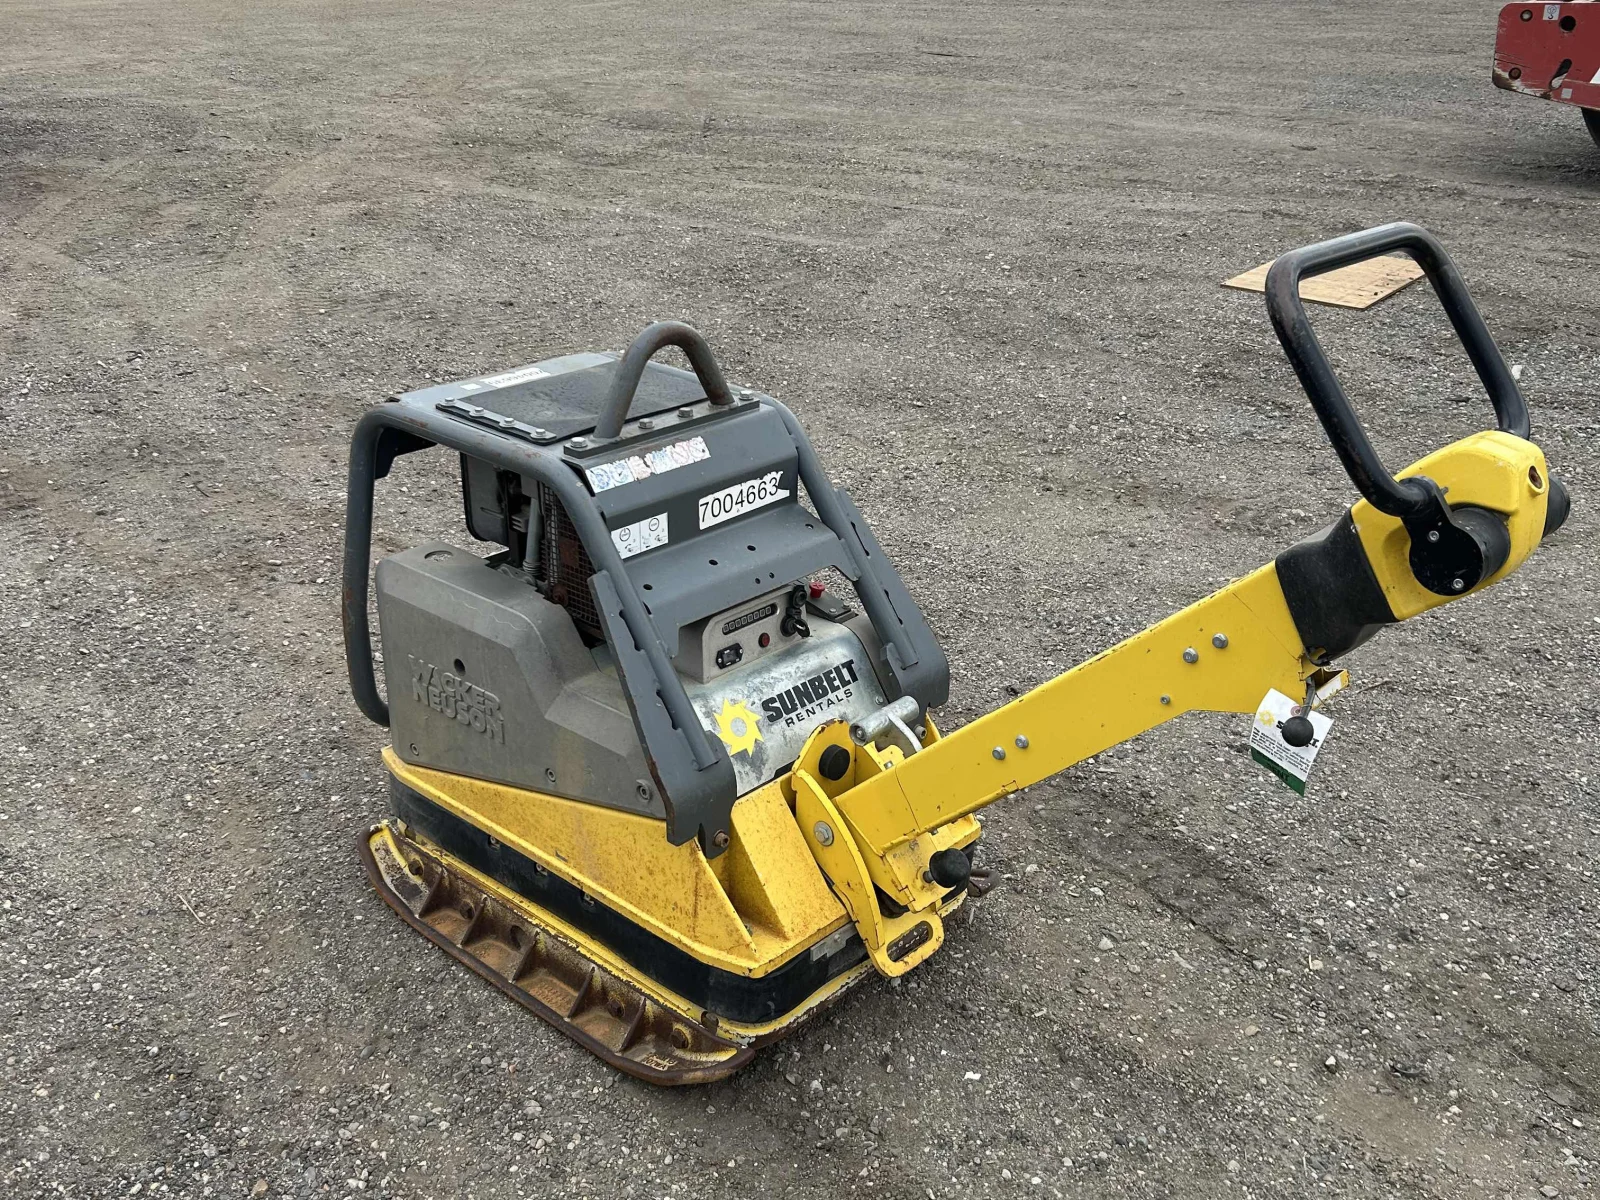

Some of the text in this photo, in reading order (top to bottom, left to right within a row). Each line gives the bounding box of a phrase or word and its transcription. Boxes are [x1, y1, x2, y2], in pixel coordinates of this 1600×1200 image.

[700, 477, 778, 522] 7004663
[408, 654, 504, 721] WACKER
[411, 677, 506, 744] NEUSON
[761, 659, 859, 723] SUNBELT
[784, 688, 853, 728] RENTALS
